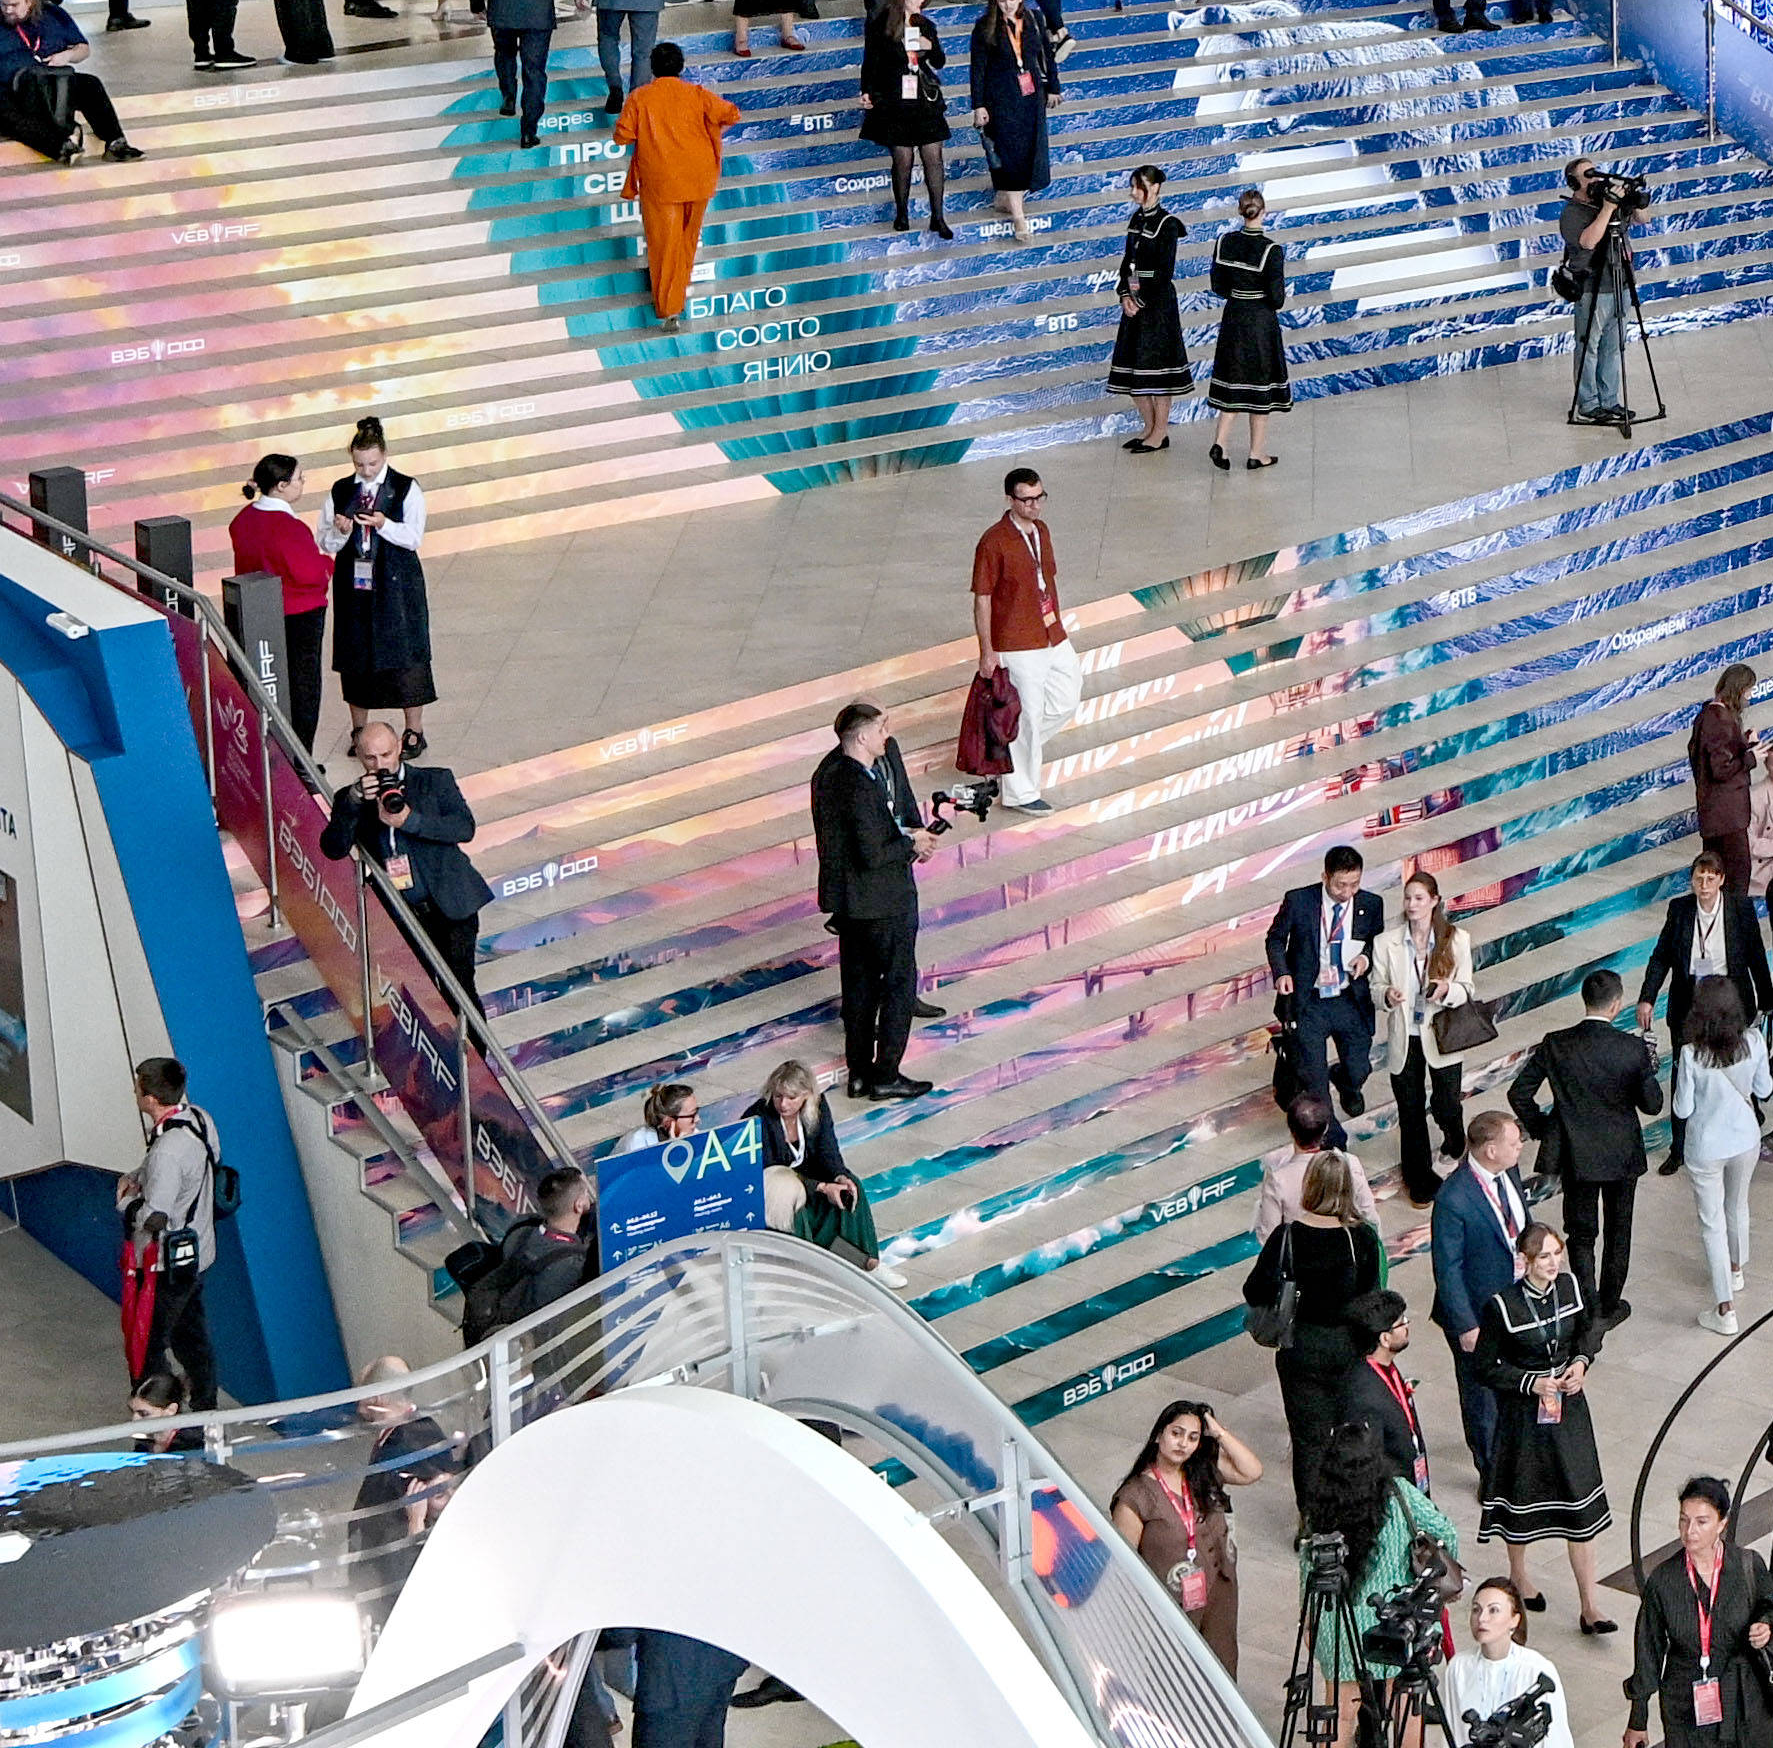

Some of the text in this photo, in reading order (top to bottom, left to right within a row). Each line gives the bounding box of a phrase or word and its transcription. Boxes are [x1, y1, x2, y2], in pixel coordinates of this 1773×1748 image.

[540, 111, 595, 131] через
[803, 114, 835, 132] ВТБ
[560, 140, 627, 166] ПРО
[834, 171, 926, 193] Сохранм
[690, 286, 788, 320] БЛАГО
[715, 316, 821, 351] СОСТО
[111, 345, 150, 364] ВЭБ
[742, 350, 833, 384] ЯНИЮ
[1450, 588, 1478, 609] ВТБ
[1610, 613, 1687, 651] Сохраняем
[600, 740, 638, 760] VEB
[503, 868, 543, 896] ВЭБ
[1150, 1175, 1238, 1223] VEB RF
[1063, 1352, 1156, 1407] ВЭБ РФ
